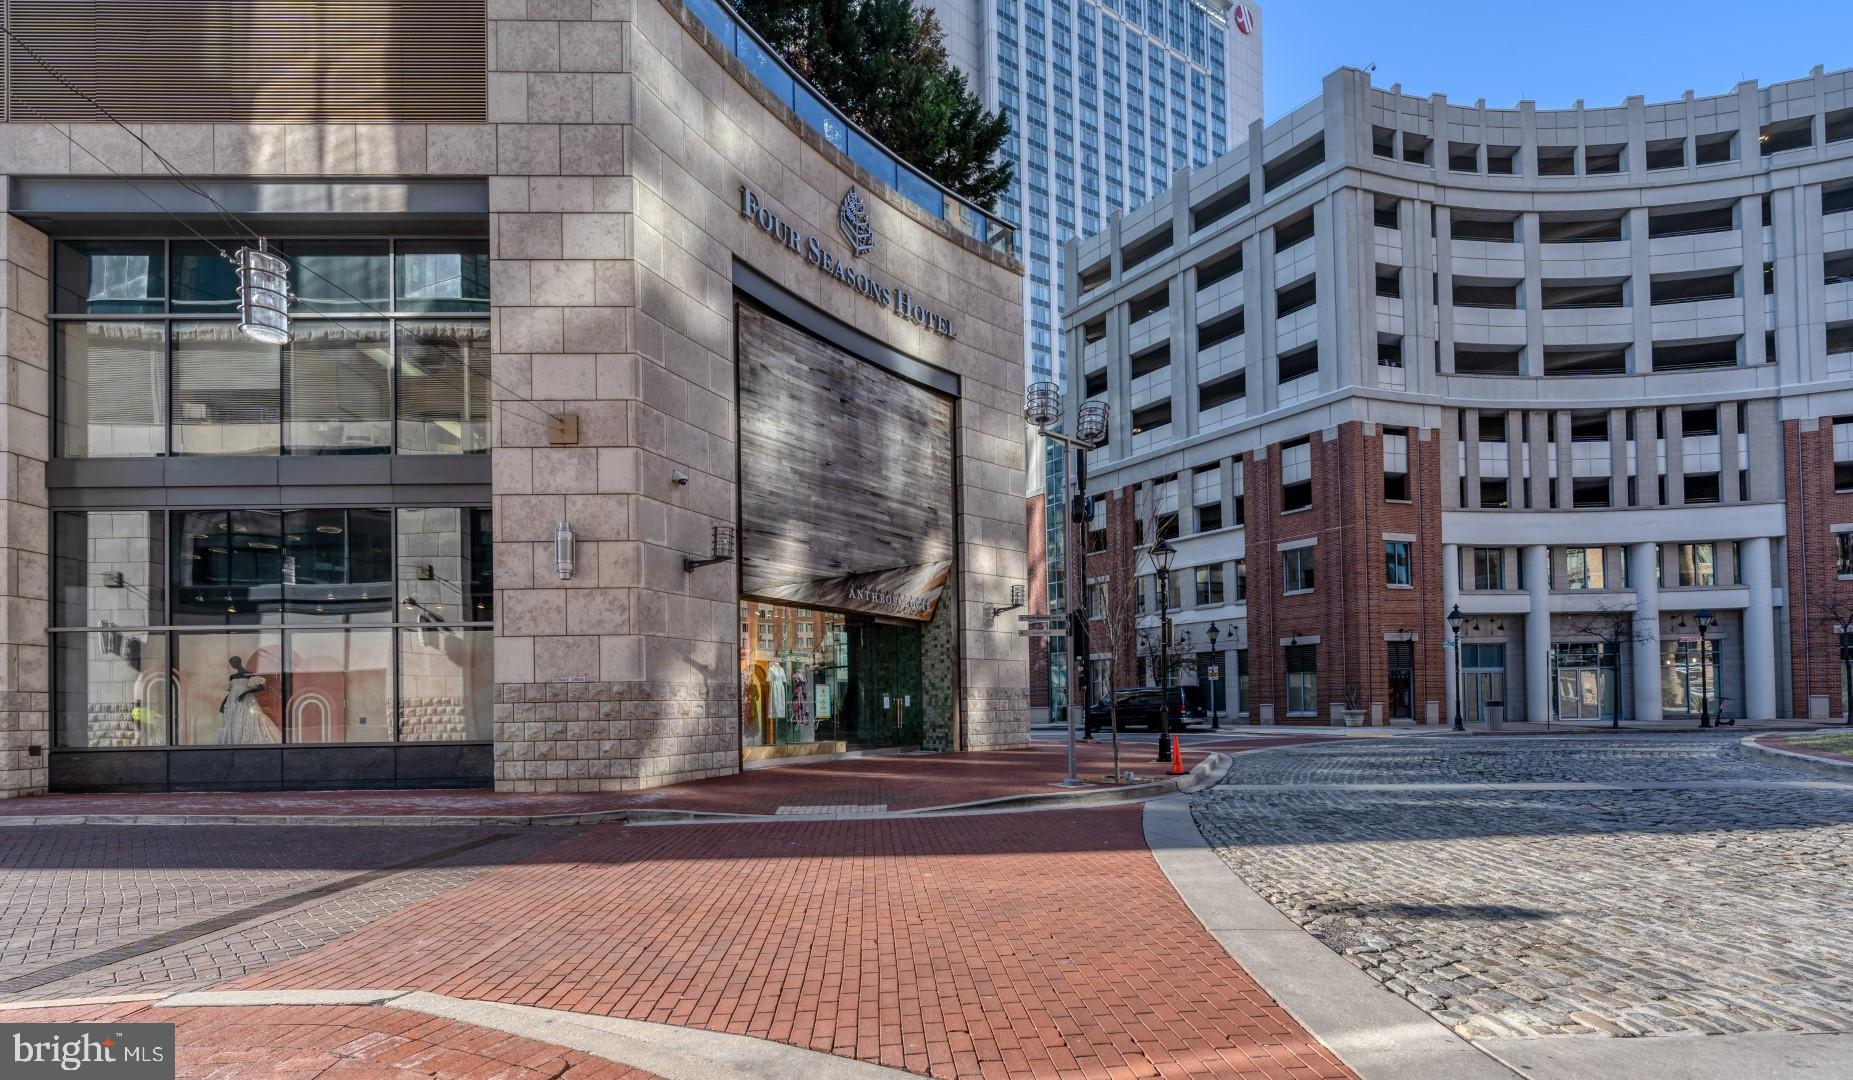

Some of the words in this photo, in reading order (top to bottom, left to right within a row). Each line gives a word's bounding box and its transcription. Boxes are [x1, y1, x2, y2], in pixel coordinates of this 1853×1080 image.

[739, 185, 801, 254] FOUR
[807, 235, 890, 306] SEASONS
[895, 288, 957, 338] HOTEL
